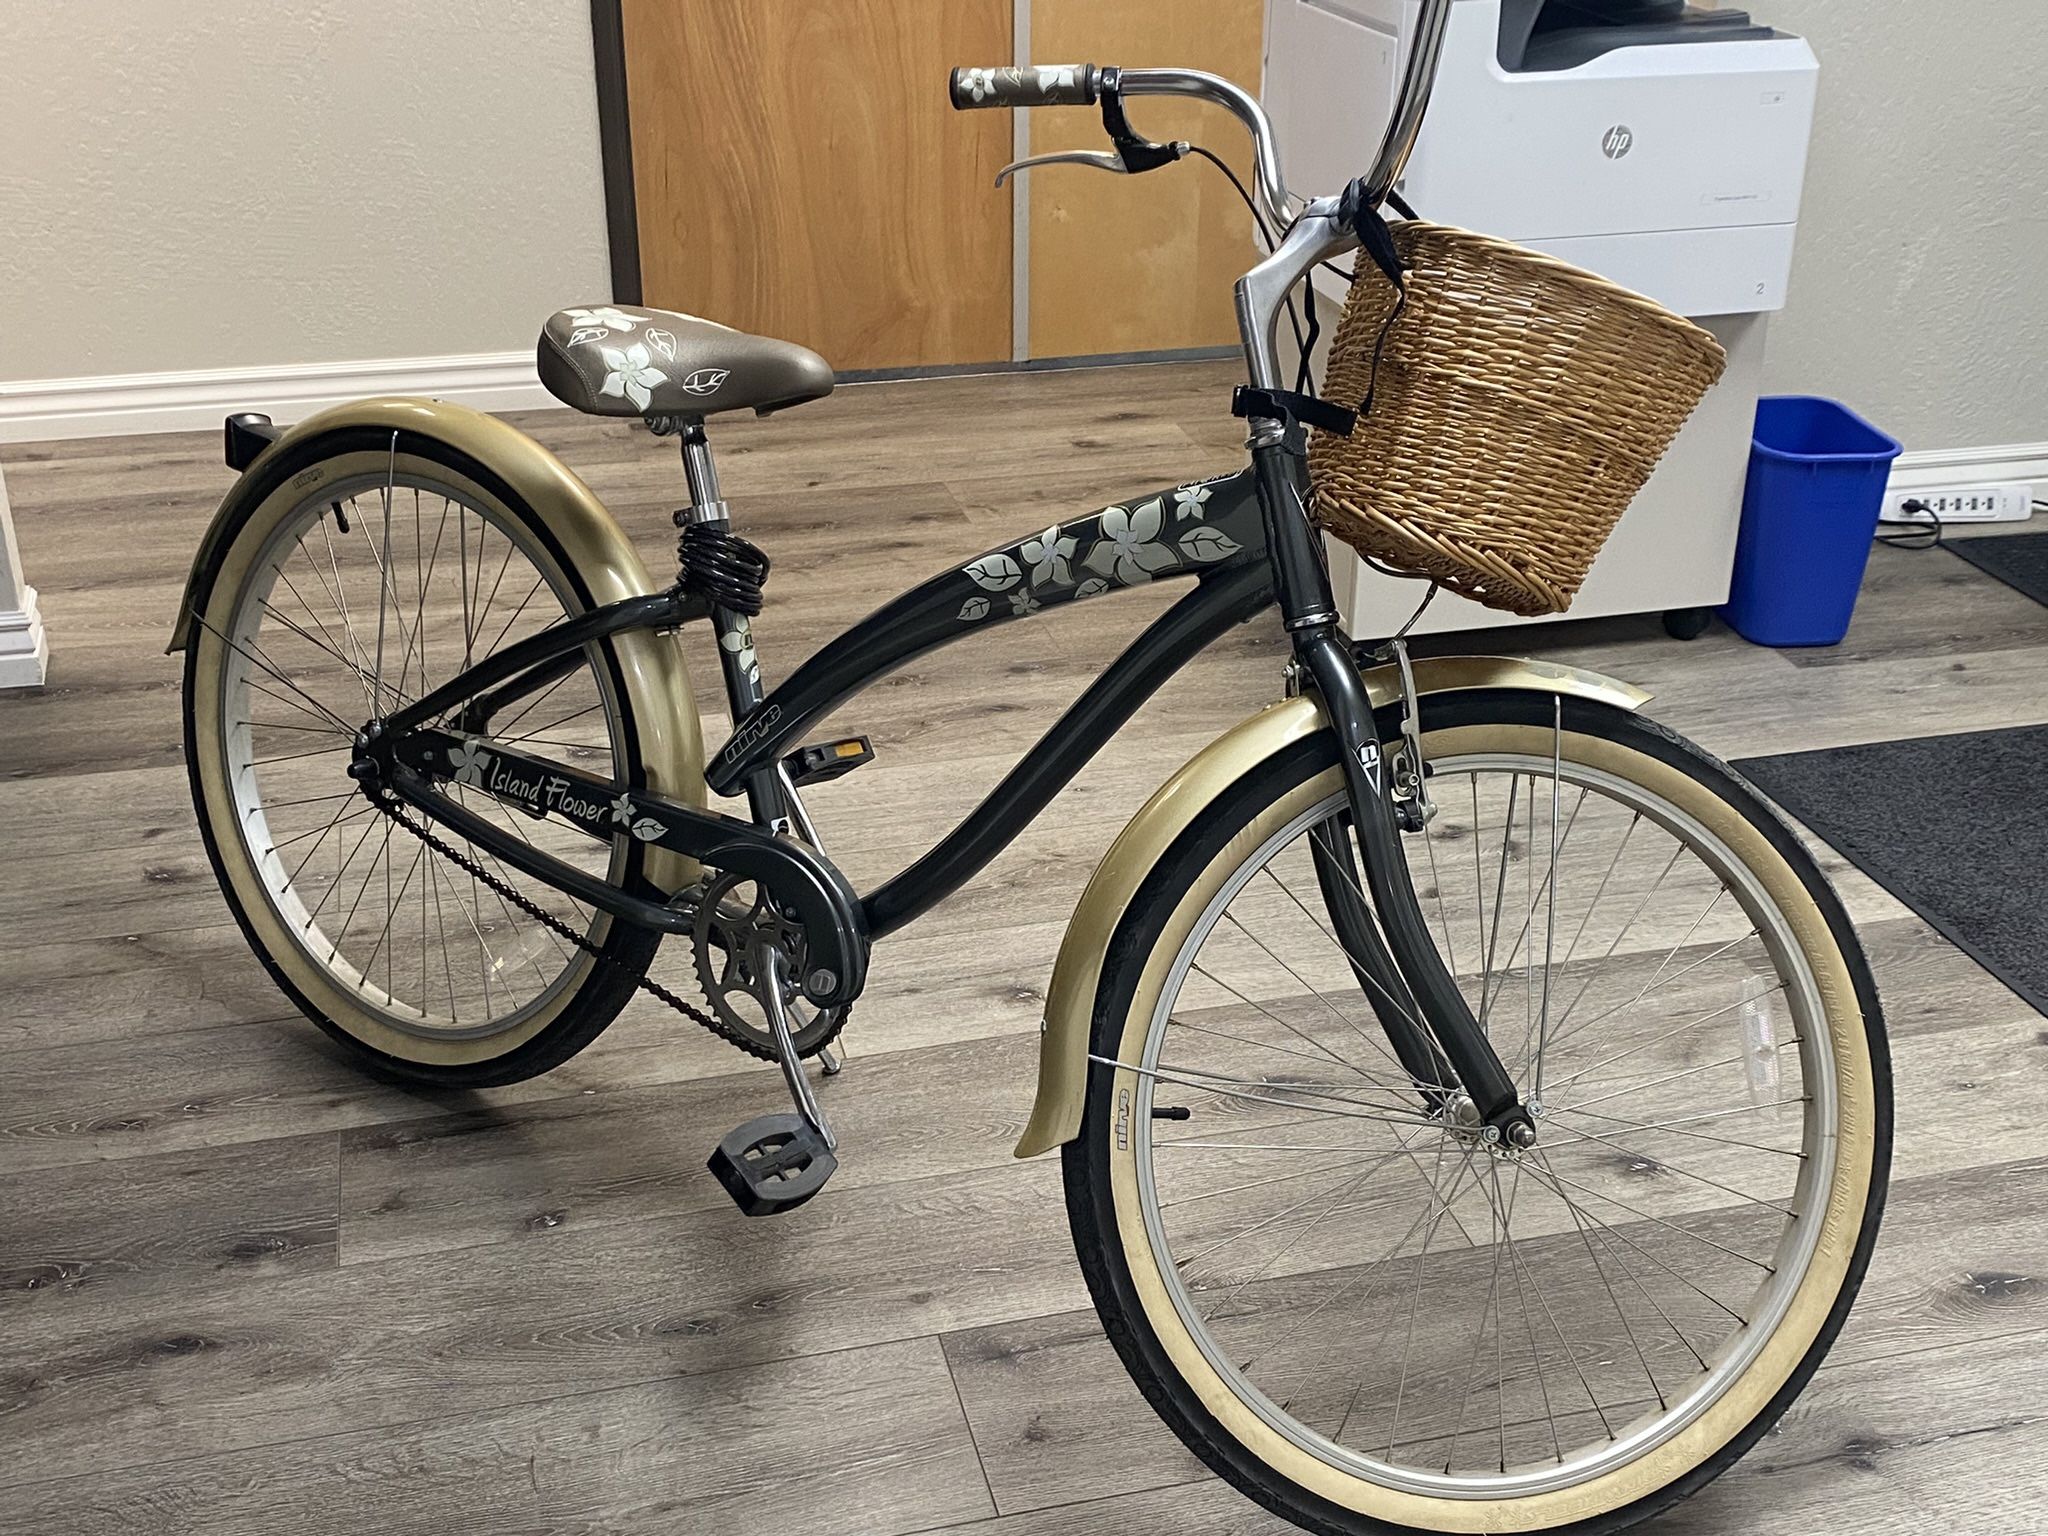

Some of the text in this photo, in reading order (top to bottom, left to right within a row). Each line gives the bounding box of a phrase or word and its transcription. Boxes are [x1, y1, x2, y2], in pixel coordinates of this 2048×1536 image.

[1605, 126, 1630, 160] hp
[1756, 282, 1765, 295] 2
[489, 757, 609, 824] Island Flower
